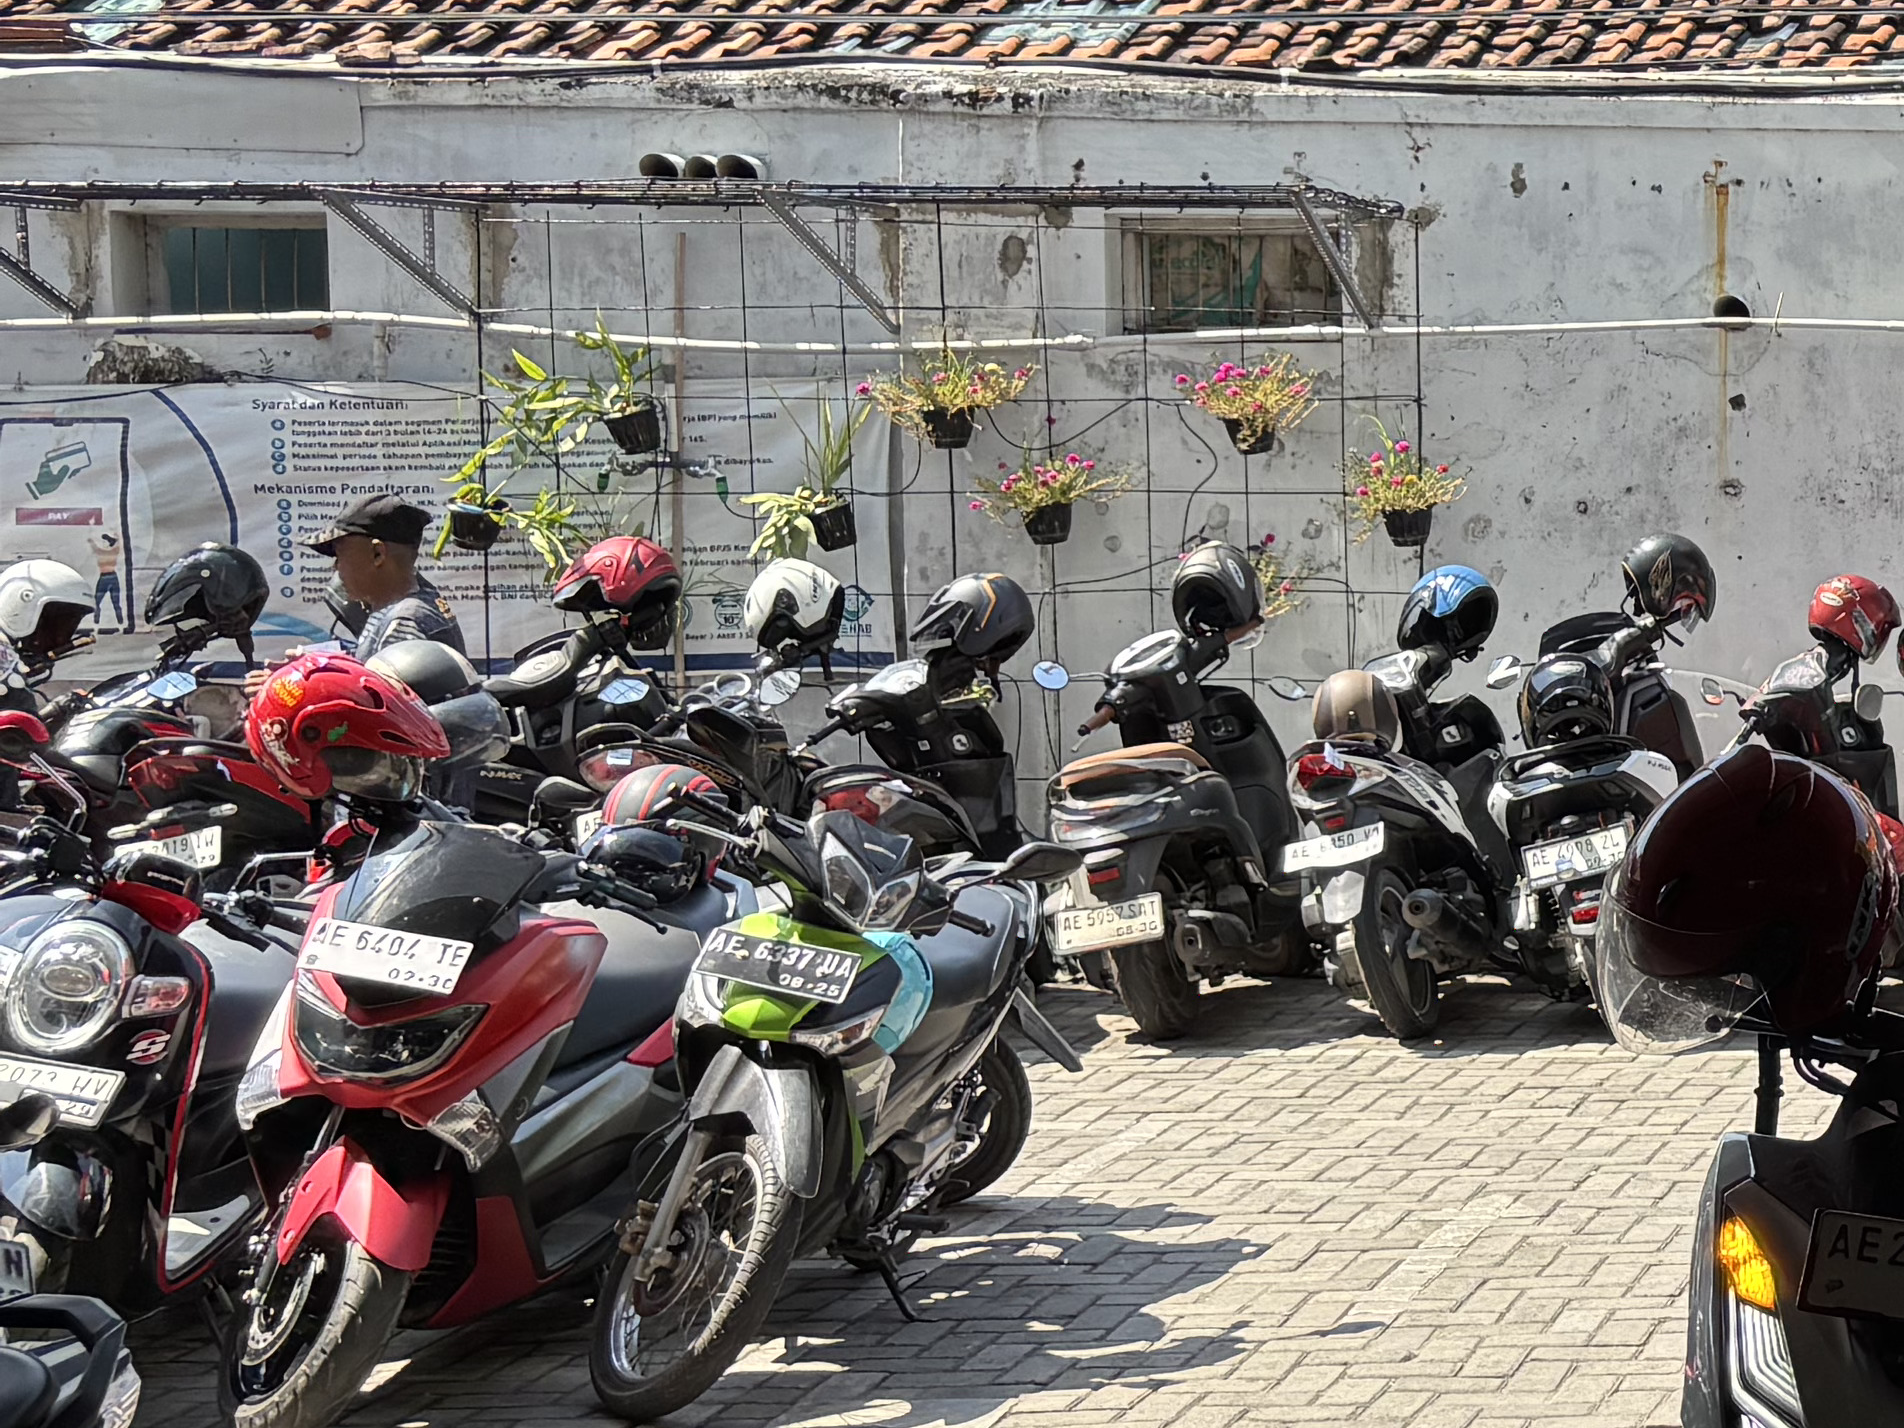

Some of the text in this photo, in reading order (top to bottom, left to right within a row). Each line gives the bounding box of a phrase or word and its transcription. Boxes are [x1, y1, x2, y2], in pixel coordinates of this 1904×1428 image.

[252, 399, 297, 412] Syarat
[301, 400, 324, 410] dan
[254, 483, 337, 495] Mekanisme
[48, 512, 70, 520] PAY
[1532, 849, 1551, 868] AE
[1063, 915, 1082, 932] AE
[1087, 906, 1124, 927] 5957
[312, 922, 468, 968] AE 6404 TE
[707, 932, 745, 954] AE
[754, 941, 816, 971] 6337
[1828, 1223, 1883, 1264] AE
